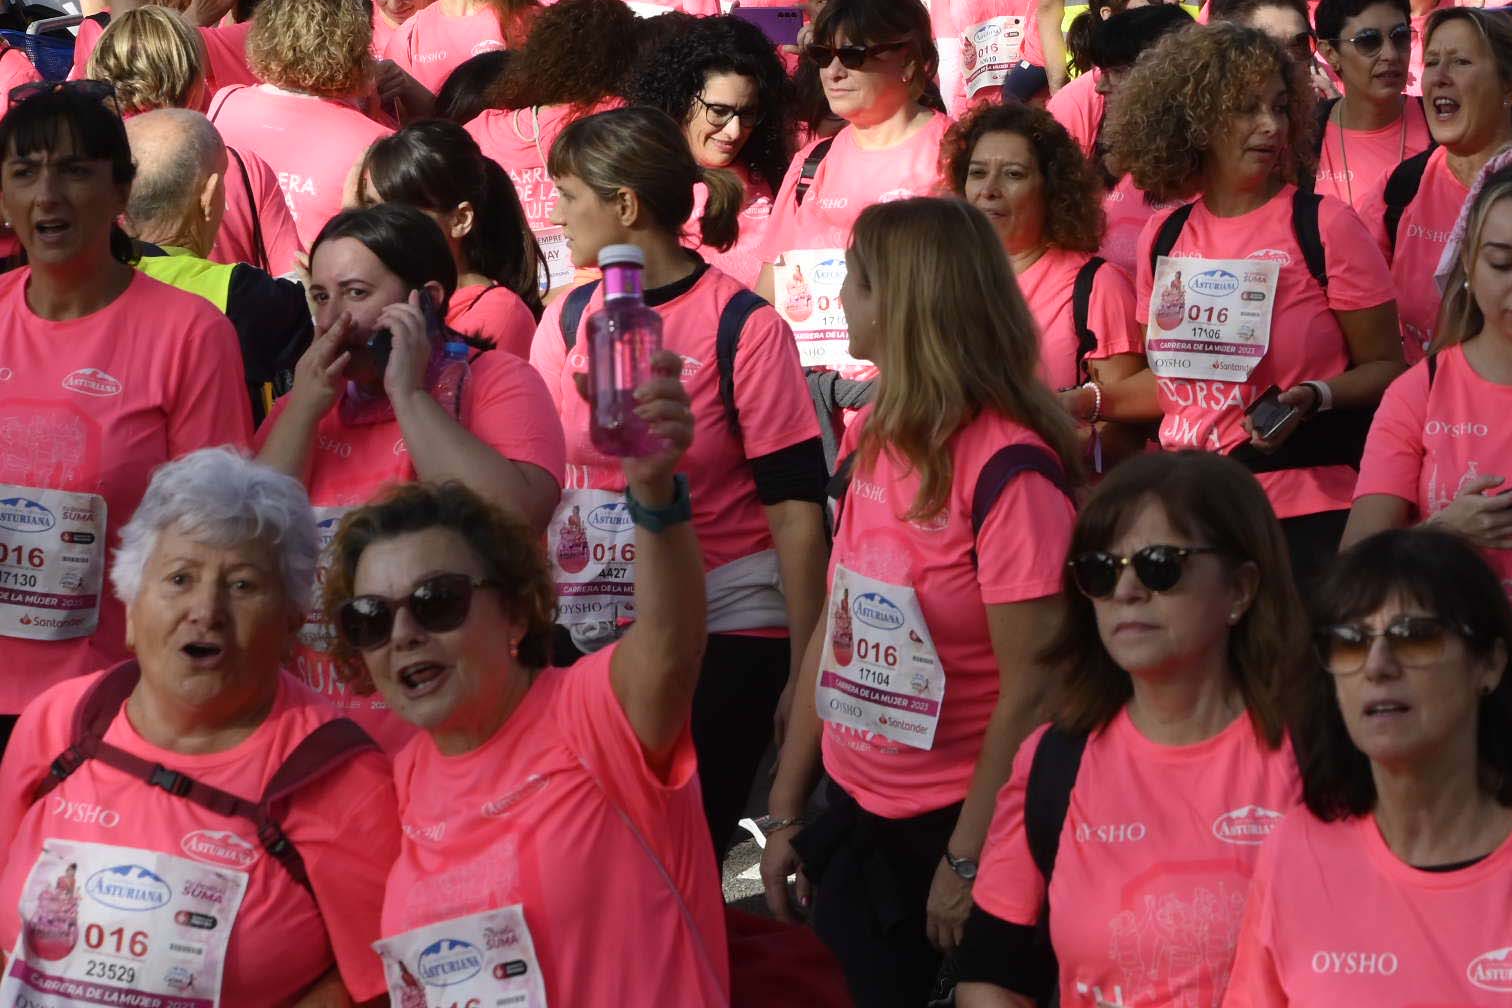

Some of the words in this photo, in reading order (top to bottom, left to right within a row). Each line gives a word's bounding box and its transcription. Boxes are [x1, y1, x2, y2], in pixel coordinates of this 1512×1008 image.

[278, 172, 315, 195] ERA
[540, 182, 560, 200] LA
[538, 233, 562, 244] EMPRE
[1192, 278, 1238, 292] ASTURIANA
[818, 295, 843, 311] 01
[1188, 304, 1229, 324] 016
[1160, 342, 1192, 351] CARRERA
[1193, 343, 1201, 352] DE
[1202, 343, 1212, 352] LA
[1155, 358, 1191, 369] OYSHO
[1426, 420, 1488, 439] OYSHO
[62, 511, 94, 522] SUMA
[593, 542, 635, 562] 016
[11, 592, 24, 601] LA
[25, 593, 58, 607] MUJER
[857, 602, 900, 626] ASTURIANA
[857, 637, 898, 666] 016
[858, 667, 890, 687] 17104
[870, 691, 880, 701] LA
[881, 693, 909, 708] MUJER
[888, 716, 929, 734] Santander
[94, 876, 164, 906] ASTURIANA
[85, 922, 150, 958] 016
[85, 959, 136, 985] 23529
[422, 954, 480, 979] ASTURIANA
[1312, 951, 1398, 975] OYSHO
[30, 973, 86, 998] CARRERA
[87, 985, 102, 1000] DE
[103, 988, 118, 1003] LA
[117, 990, 161, 1008] MUJER
